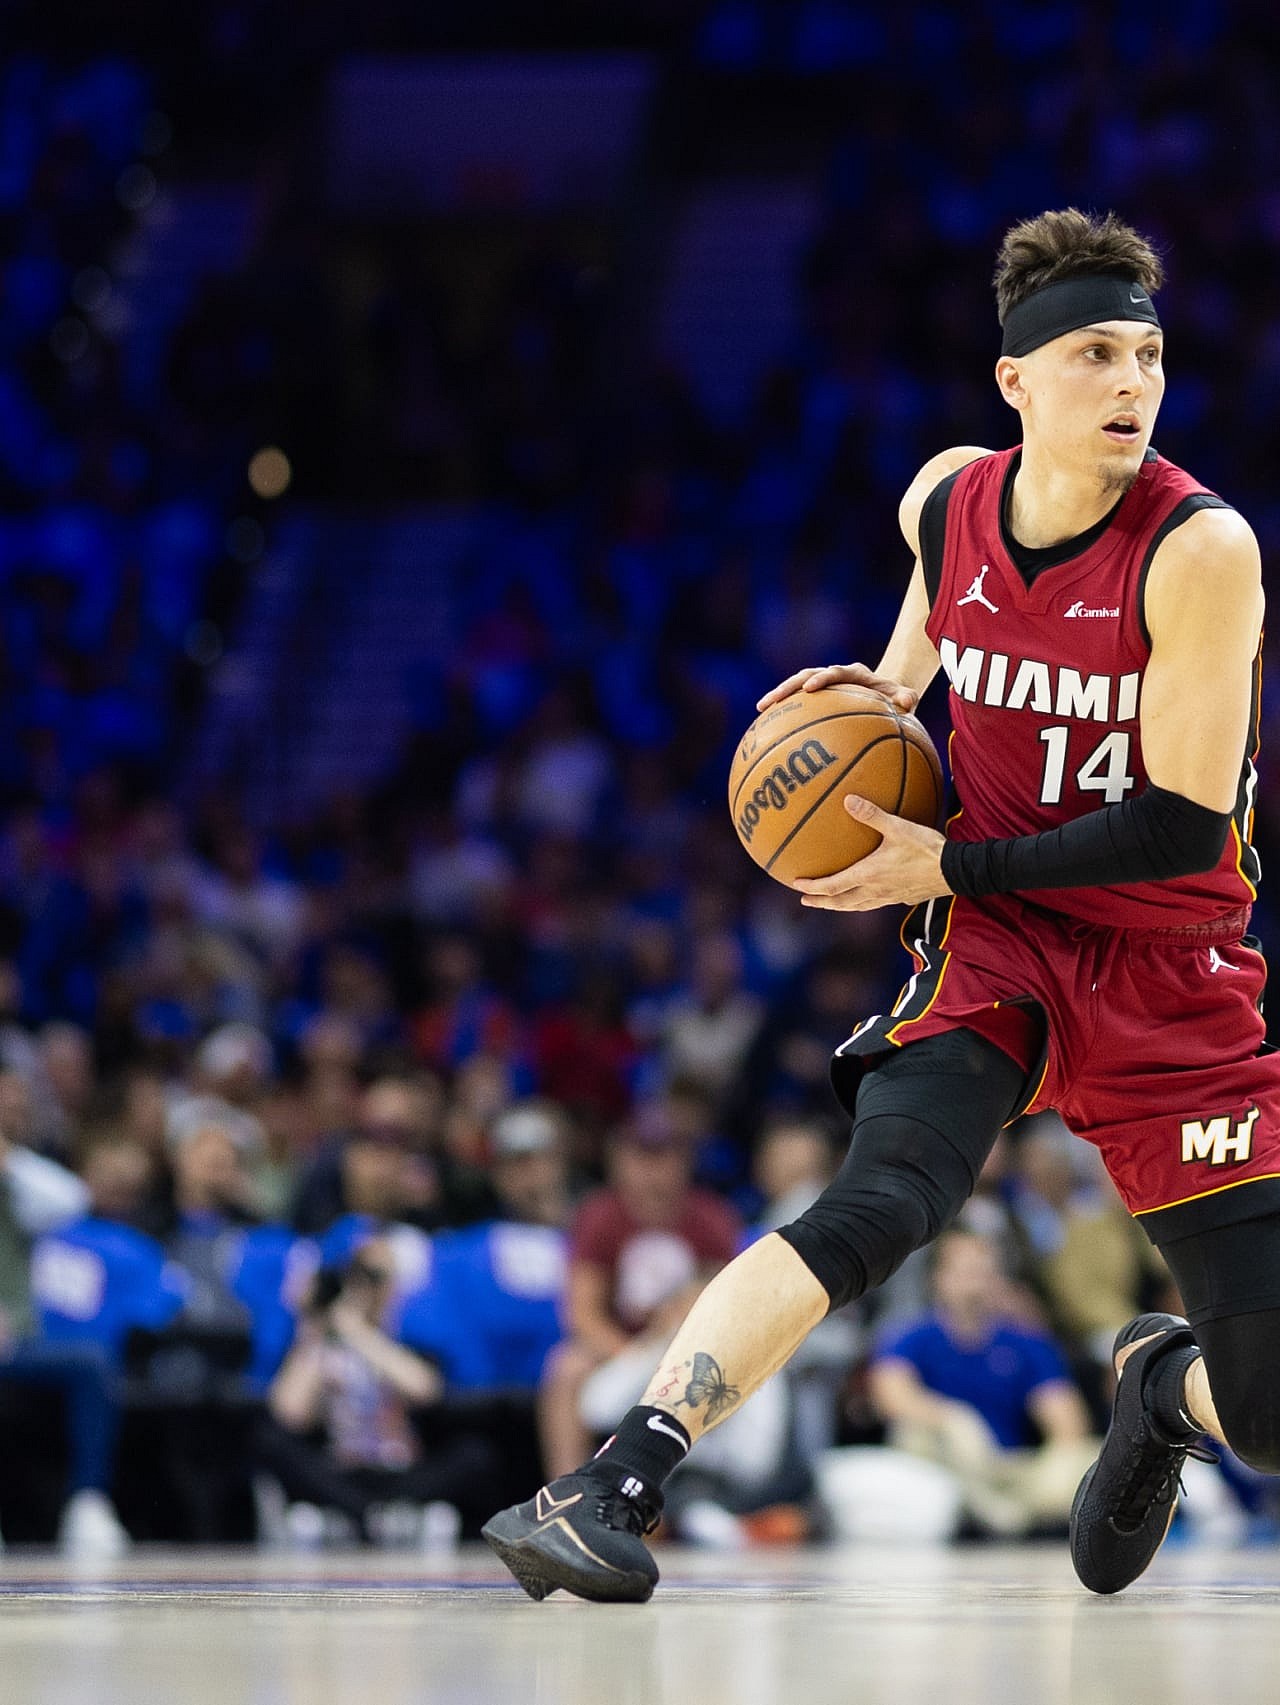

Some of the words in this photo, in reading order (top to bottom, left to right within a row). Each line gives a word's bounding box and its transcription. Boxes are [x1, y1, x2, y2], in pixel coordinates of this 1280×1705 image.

[1077, 606, 1120, 618] Carnival
[939, 636, 1141, 722] MIAMI
[737, 738, 839, 844] Wilson
[1039, 725, 1135, 804] 14
